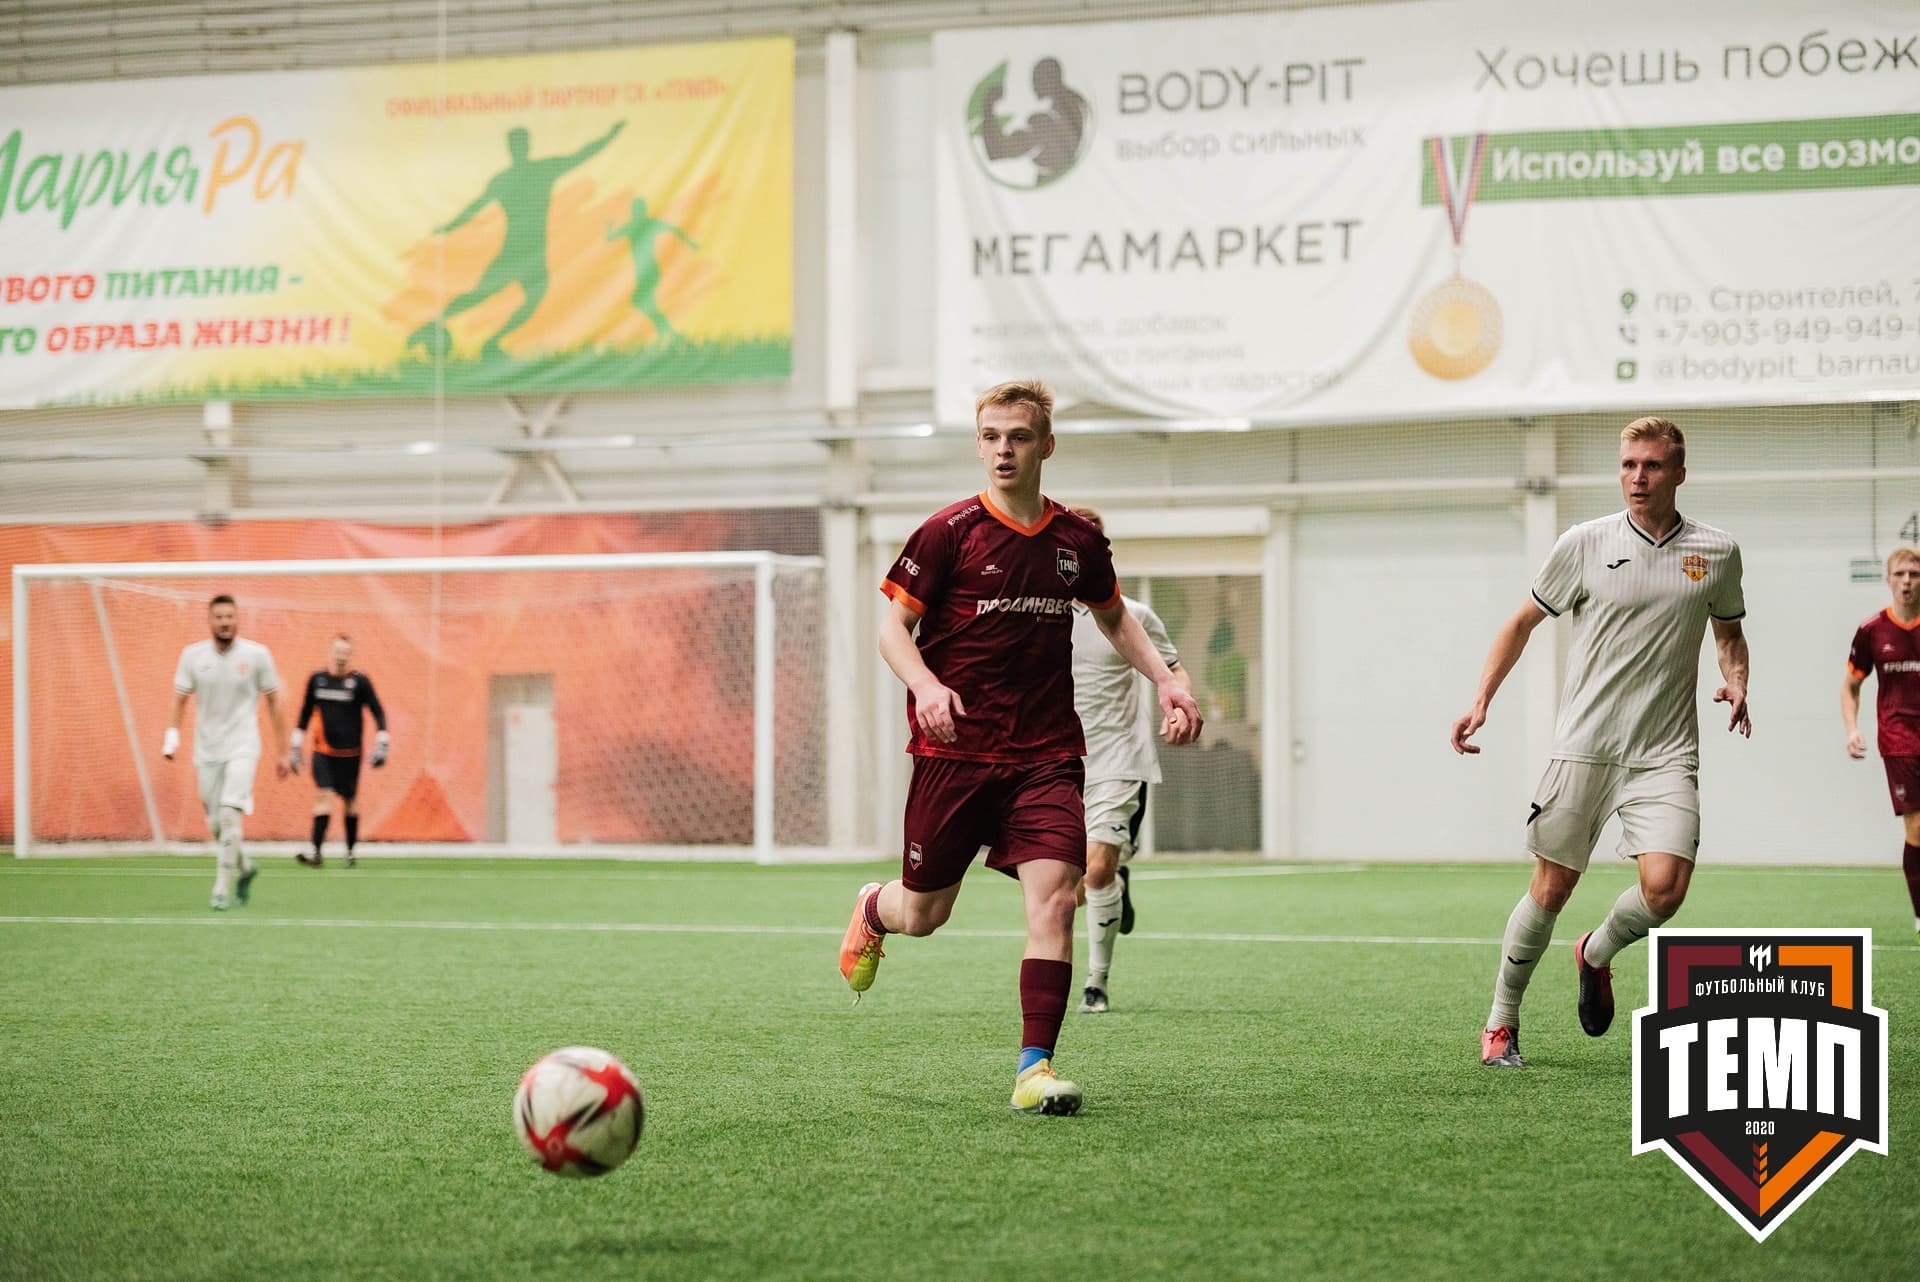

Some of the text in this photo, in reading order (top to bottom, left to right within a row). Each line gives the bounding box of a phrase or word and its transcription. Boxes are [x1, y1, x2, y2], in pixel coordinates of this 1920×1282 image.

[1474, 30, 1920, 93] Хочешь побеж
[1117, 57, 1367, 116] BODY-PIT
[1115, 125, 1367, 162] выбор сильных
[1492, 136, 1920, 184] Используй все возмо
[970, 219, 1364, 278] МЕГАМАРКЕТ
[0, 273, 96, 304] ВОГО
[103, 265, 281, 300] ПИТАНИЯ
[1708, 279, 1901, 313] Строителей,
[45, 320, 182, 354] ОБРАЗА
[1655, 314, 1920, 347] +7-903-949-949-
